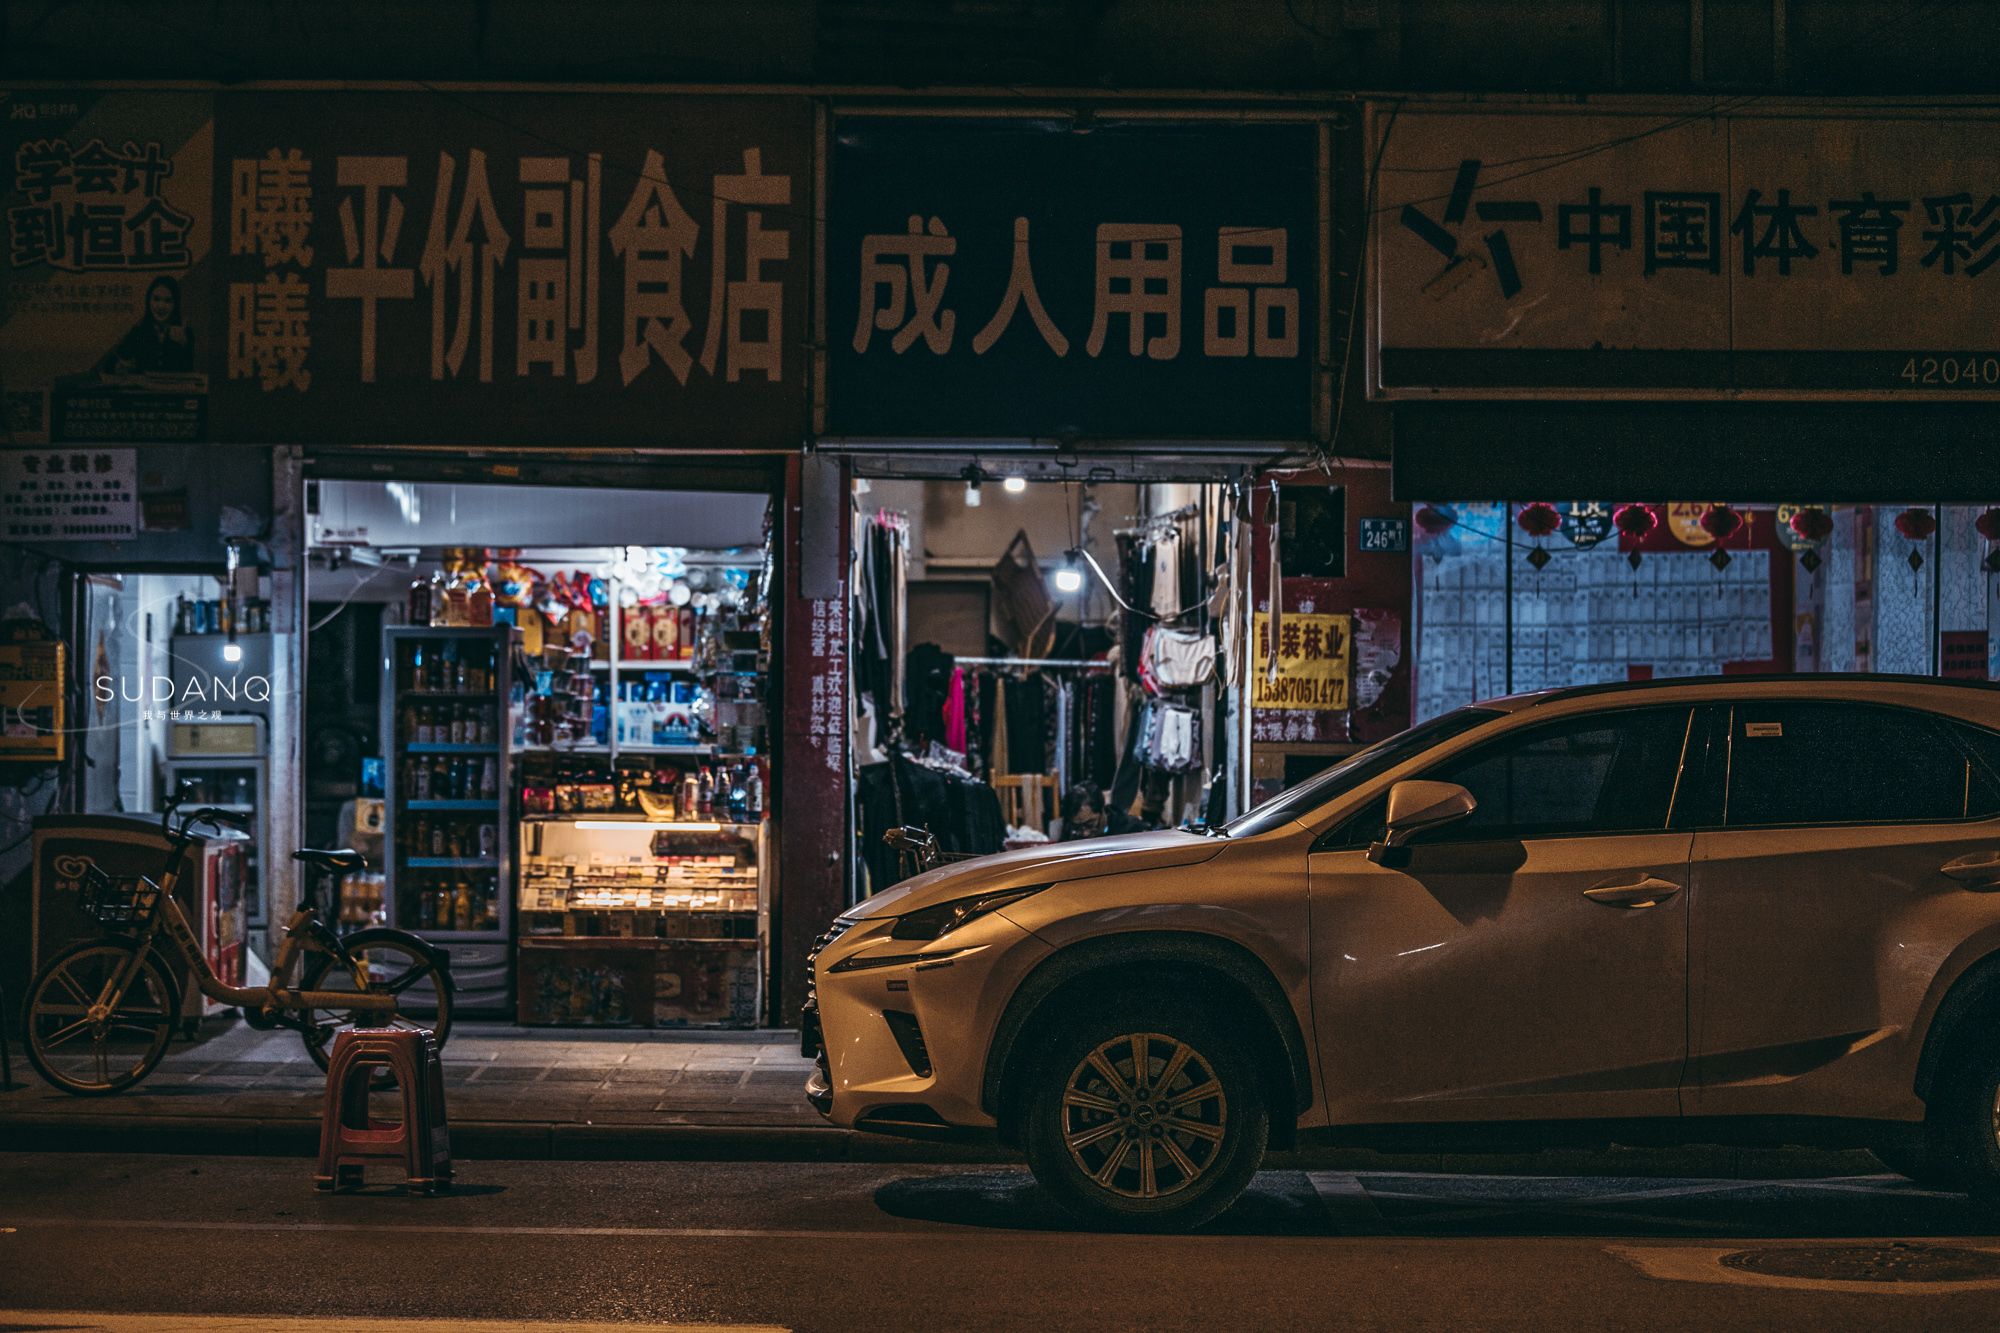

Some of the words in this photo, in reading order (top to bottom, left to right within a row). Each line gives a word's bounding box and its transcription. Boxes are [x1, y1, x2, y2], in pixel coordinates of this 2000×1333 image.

[17, 140, 172, 202] 学会计
[8, 200, 194, 270] 到恒企
[1558, 187, 2000, 278] 中国体育彩
[325, 147, 791, 388] 平价副食店
[851, 214, 1300, 361] 成人用品
[1901, 357, 2000, 384] 42040
[22, 454, 113, 474] 专业装修
[1257, 677, 1344, 704] 15387051477
